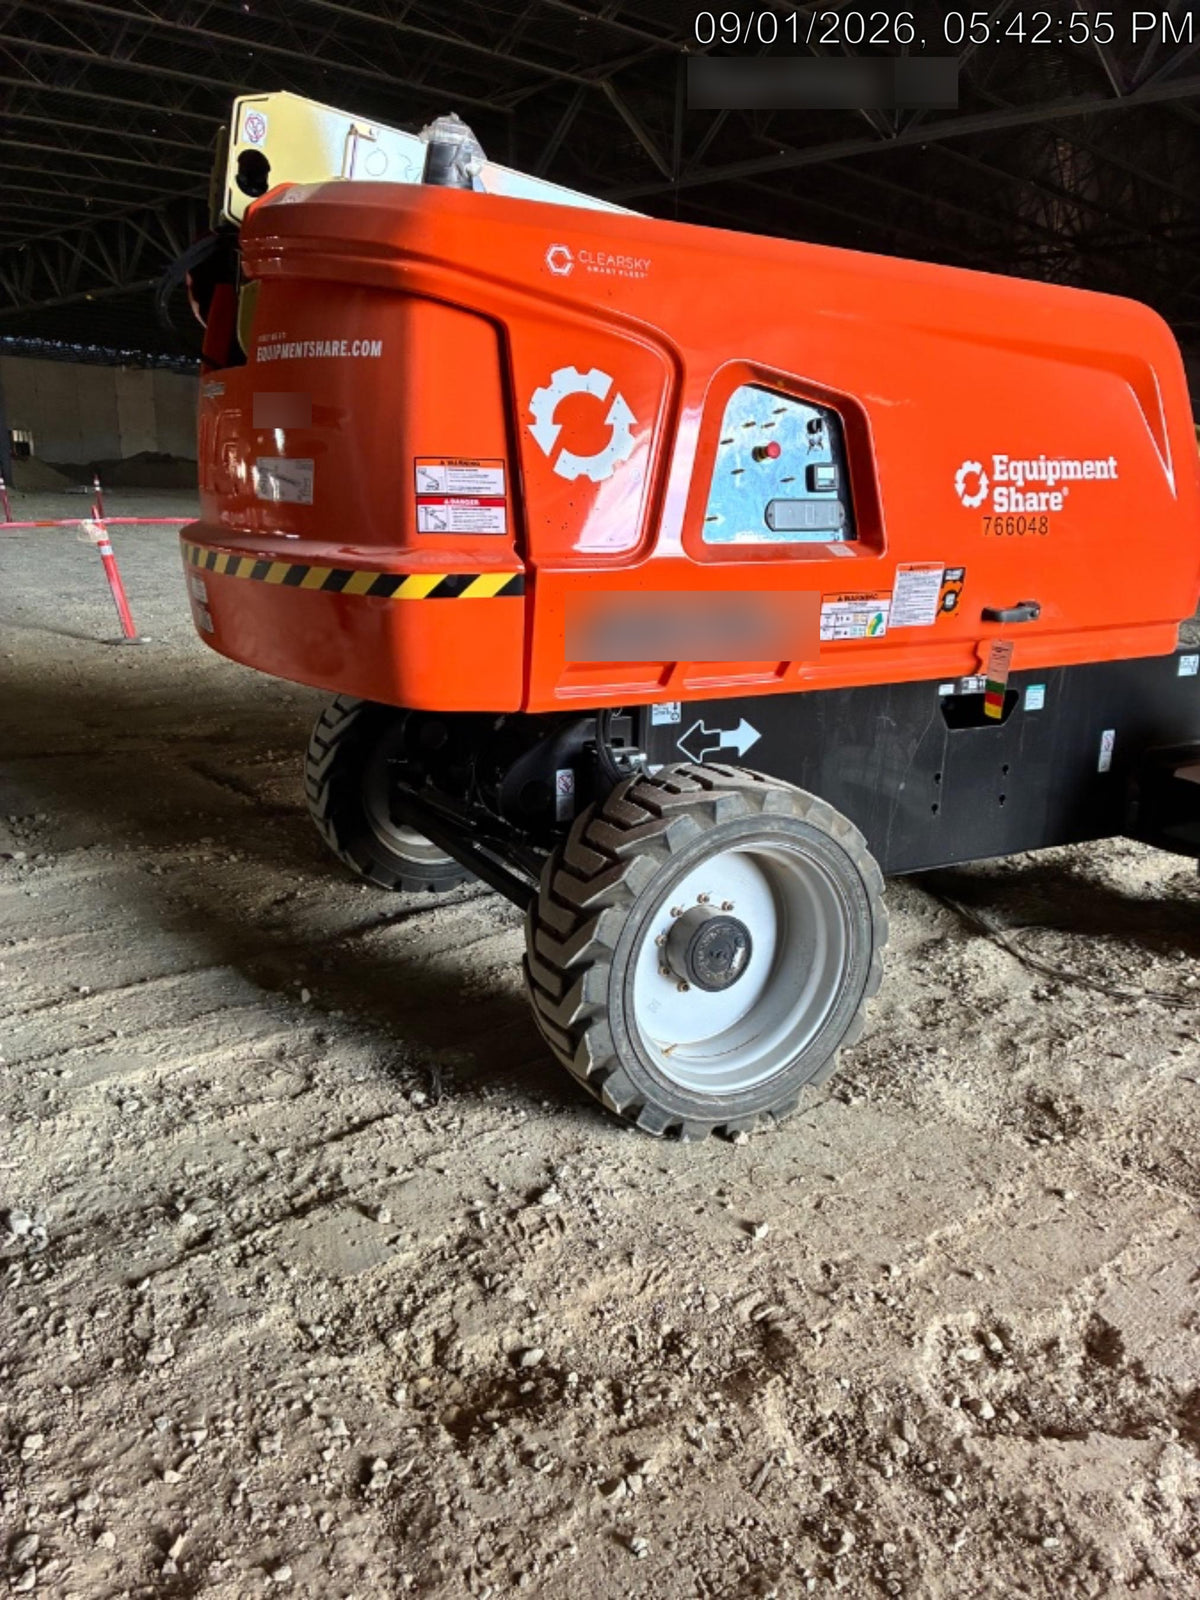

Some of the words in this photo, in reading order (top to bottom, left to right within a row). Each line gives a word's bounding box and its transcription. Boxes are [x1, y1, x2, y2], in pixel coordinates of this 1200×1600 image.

[578, 249, 651, 270] CLEARSKY
[256, 340, 383, 362] EQUIPMENTSHARE.COM
[992, 455, 1118, 486] Equipment
[982, 516, 1049, 535] 766048
